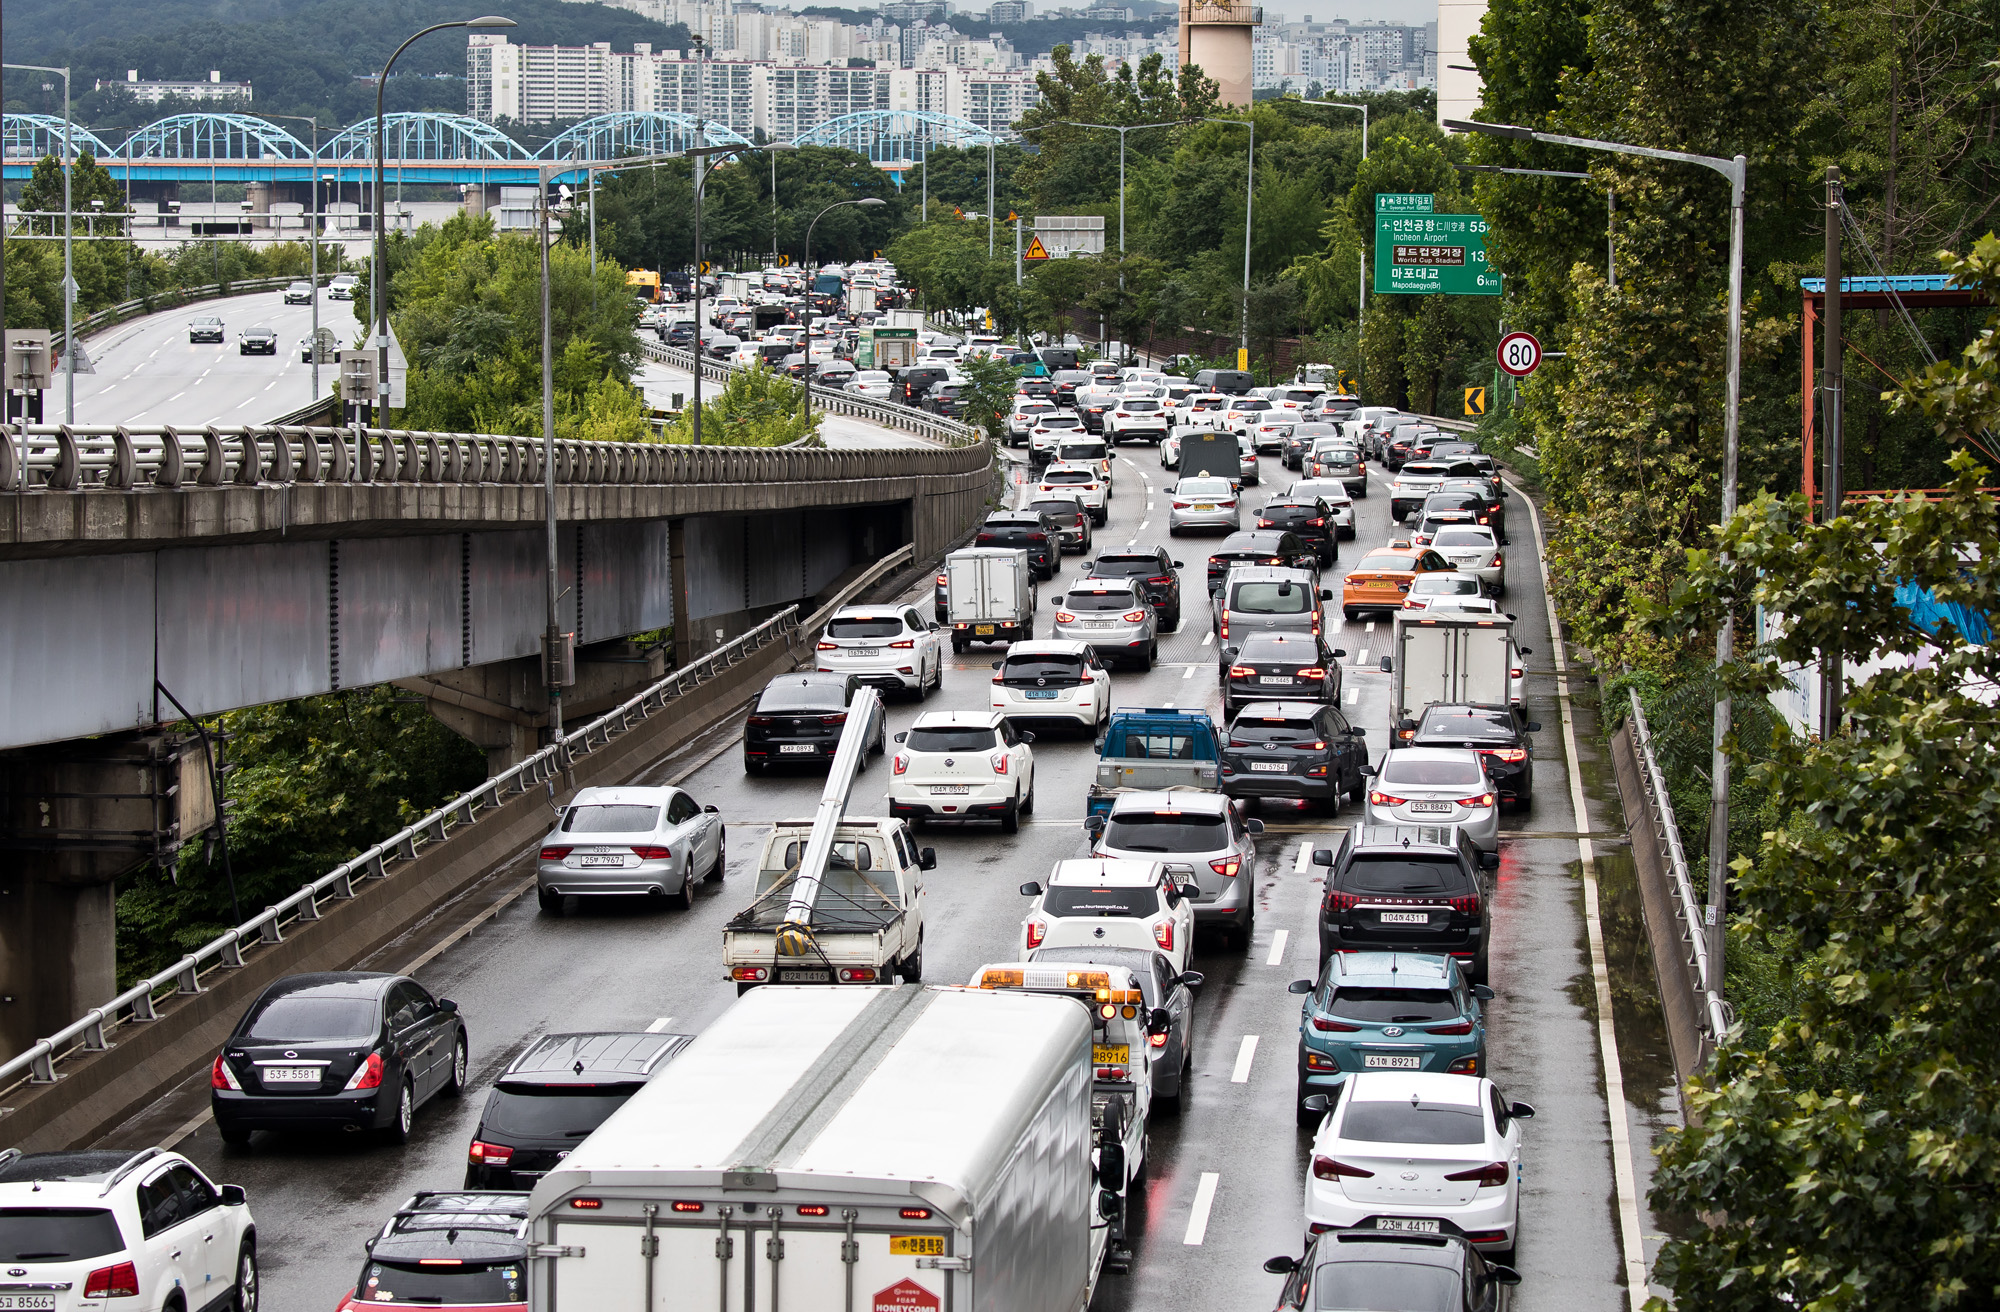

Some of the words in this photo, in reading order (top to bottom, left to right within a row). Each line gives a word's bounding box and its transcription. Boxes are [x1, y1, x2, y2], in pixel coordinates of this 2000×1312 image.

[1393, 219, 1435, 232] 인천공항
[1436, 221, 1466, 232] 仁川空港
[1393, 233, 1421, 241] Incheon
[1423, 233, 1448, 243] Airport
[1397, 246, 1462, 257] 월드컵경기장
[1471, 250, 1485, 262] 13
[1391, 267, 1439, 280] 마포대교
[1391, 281, 1441, 290] Mapodaegyo(Br)
[1509, 344, 1532, 366] 80
[805, 972, 825, 980] 1416
[1392, 1058, 1414, 1067] 8921
[270, 1070, 288, 1079] 53주
[292, 1070, 314, 1079] 5581
[1406, 1221, 1434, 1232] 4417
[18, 1297, 48, 1308] 8566
